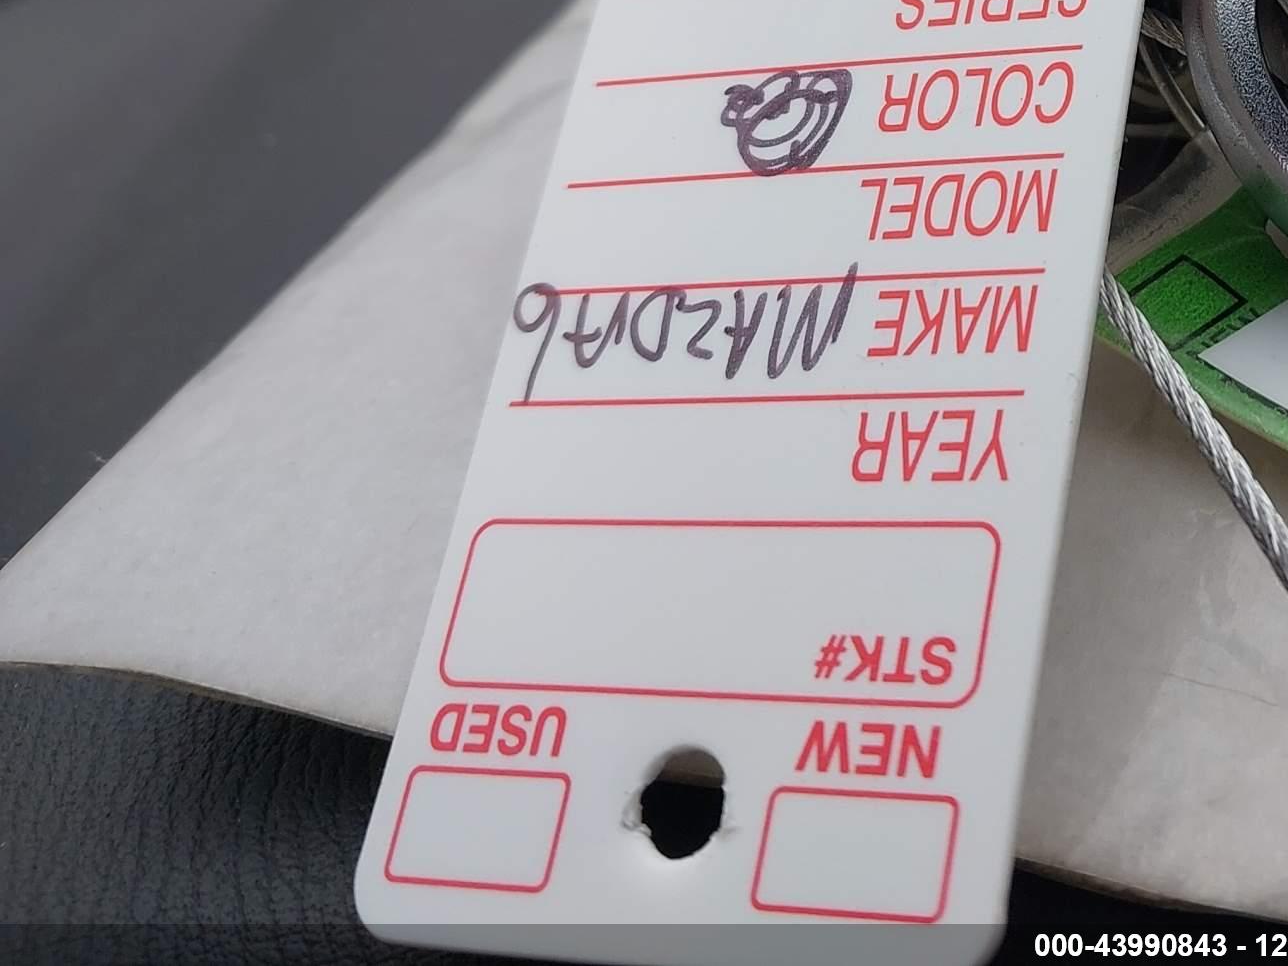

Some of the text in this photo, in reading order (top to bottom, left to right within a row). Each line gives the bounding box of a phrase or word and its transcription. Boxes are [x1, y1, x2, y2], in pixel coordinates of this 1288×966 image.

[877, 61, 1074, 133] COLOR
[861, 169, 1058, 241] MODEL
[867, 284, 1039, 358] MAKE
[851, 409, 1008, 484] YEAR
[815, 634, 957, 687] STK#
[429, 702, 568, 758] USED
[795, 719, 941, 779] NEW
